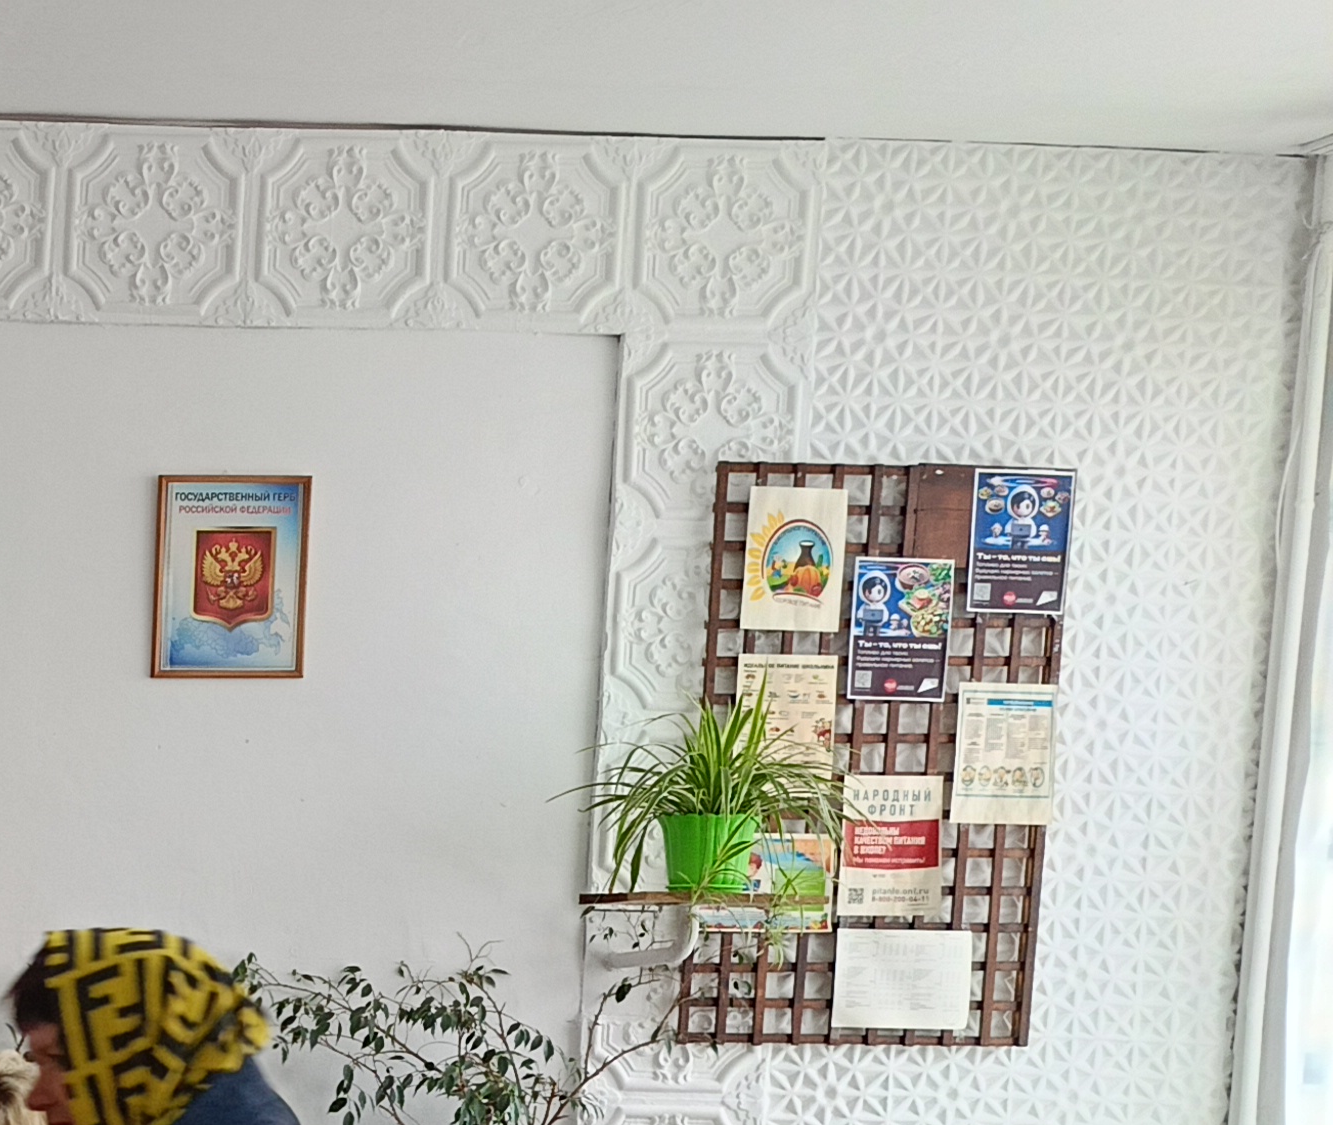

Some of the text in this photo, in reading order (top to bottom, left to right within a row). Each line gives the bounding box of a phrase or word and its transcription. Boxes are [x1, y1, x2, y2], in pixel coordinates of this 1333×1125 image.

[175, 490, 270, 502] ГОСУДАРСТВЕННЫЙ
[179, 503, 237, 514] РОССИЙСКОЙ
[852, 787, 932, 803] НАРОДНЫЙ
[867, 804, 915, 816] ФРОНТ
